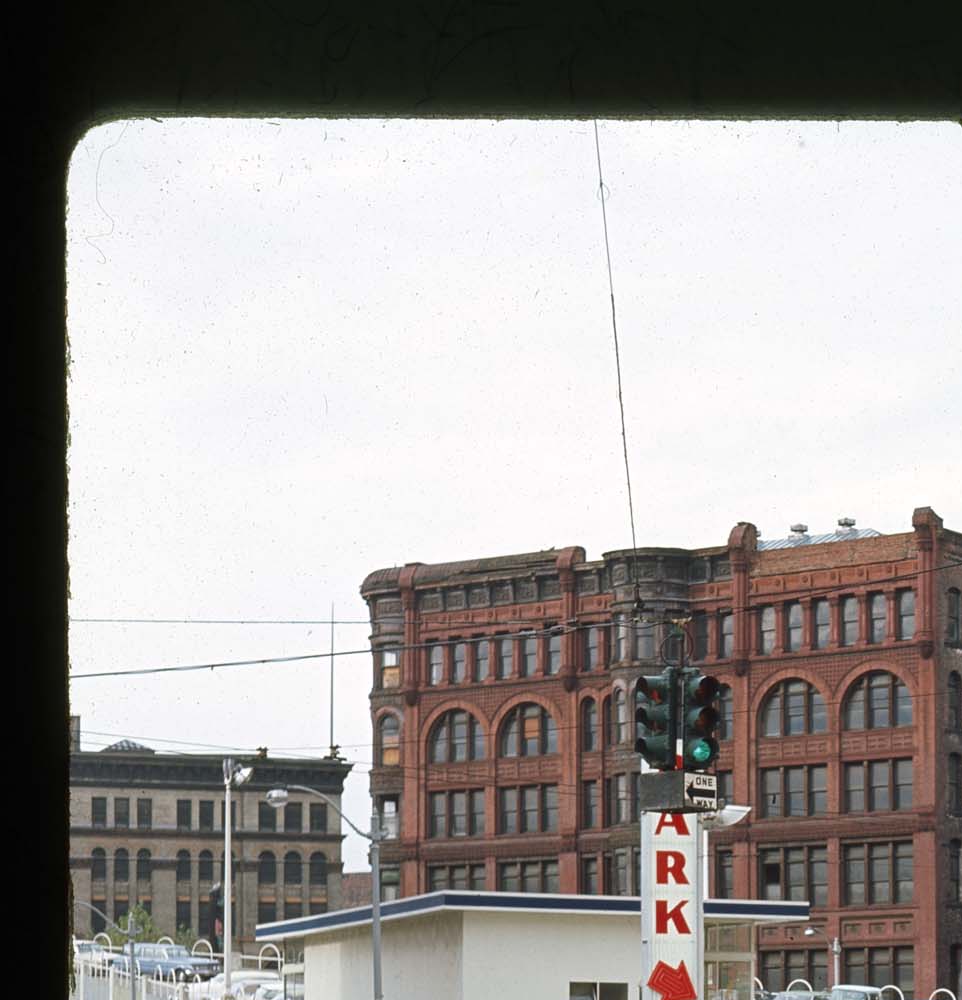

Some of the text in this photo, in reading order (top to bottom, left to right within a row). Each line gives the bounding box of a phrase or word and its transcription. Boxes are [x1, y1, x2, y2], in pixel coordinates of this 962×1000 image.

[696, 776, 713, 787] ONE
[695, 799, 713, 808] WAY
[655, 755, 692, 934] ARK
